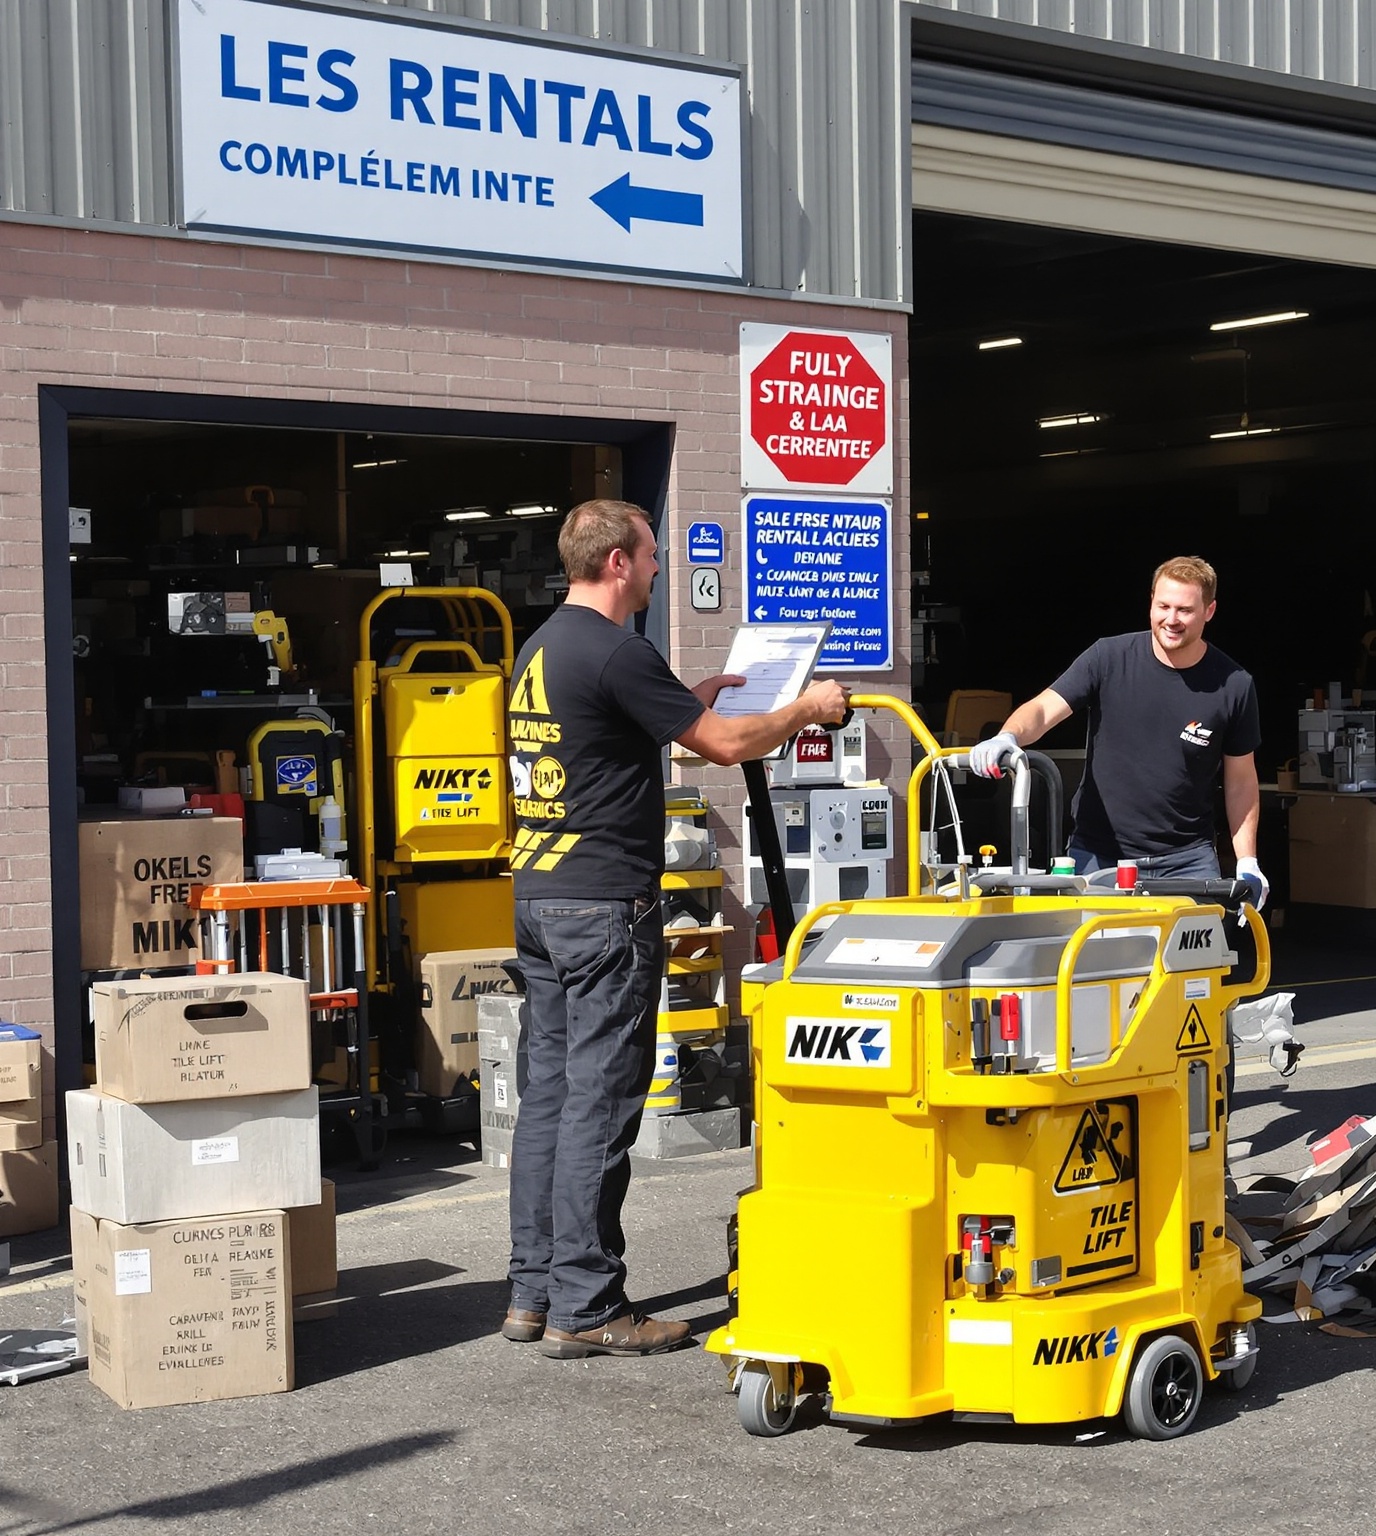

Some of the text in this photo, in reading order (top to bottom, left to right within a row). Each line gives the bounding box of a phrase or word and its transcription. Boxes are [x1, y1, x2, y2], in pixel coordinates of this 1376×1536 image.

[220, 33, 714, 161] LES RENTALS
[471, 170, 555, 208] INTE
[789, 350, 852, 378] FULY
[759, 379, 880, 410] STRAINGE
[789, 411, 848, 432] & LAA
[766, 434, 872, 459] CERRENTEE
[754, 511, 790, 527] SALE
[793, 512, 830, 528] FRSE
[133, 854, 212, 882] OKELS
[150, 882, 204, 905] FRE
[199, 1054, 226, 1066] LIFT
[1090, 1200, 1133, 1229] TILE
[1082, 1226, 1127, 1255] LIFT
[1032, 1329, 1107, 1366] NIKK
